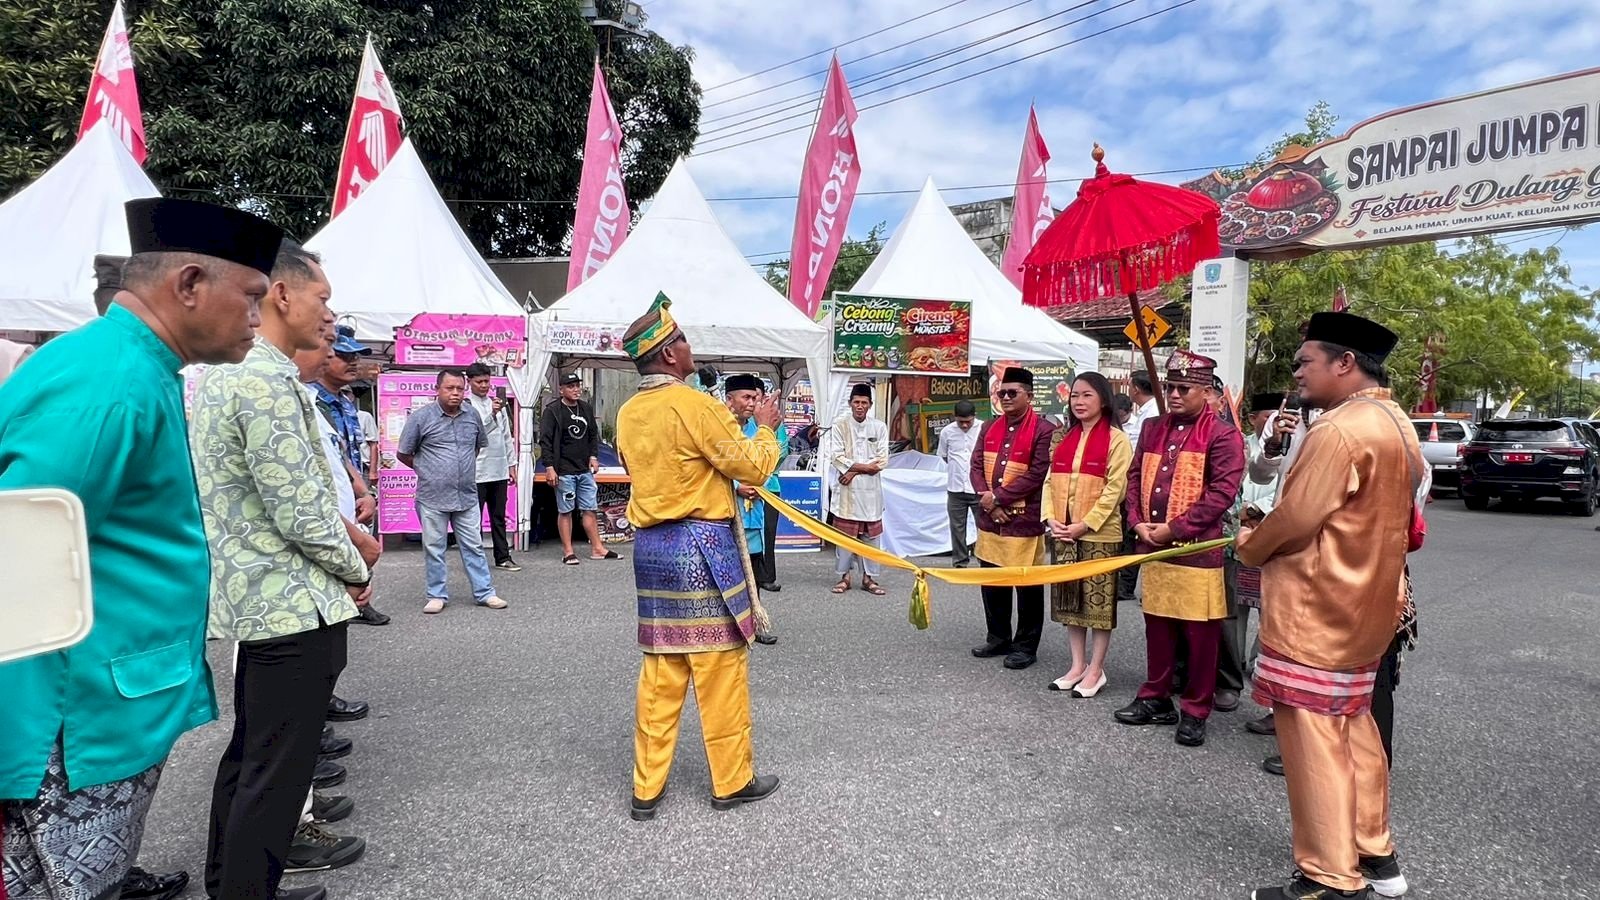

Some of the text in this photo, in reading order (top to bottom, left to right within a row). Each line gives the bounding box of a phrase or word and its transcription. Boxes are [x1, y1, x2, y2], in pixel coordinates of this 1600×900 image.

[1347, 129, 1460, 191] SAMPAI
[1465, 104, 1588, 165] JUMPA
[1350, 184, 1461, 227] Festival
[1462, 173, 1586, 207] Dulang
[1373, 224, 1413, 235] BELANJA
[1415, 219, 1449, 230] HEMAT,
[1452, 215, 1483, 226] UMKM
[1486, 211, 1514, 221] KUAT,
[843, 305, 895, 321] Cebong
[907, 308, 954, 325] Cireng
[403, 327, 514, 342] DIMSUM YUMMY
[844, 319, 895, 336] Creamy
[914, 325, 951, 334] MONSTER
[931, 378, 955, 395] Bakso
[957, 379, 972, 395] Pak
